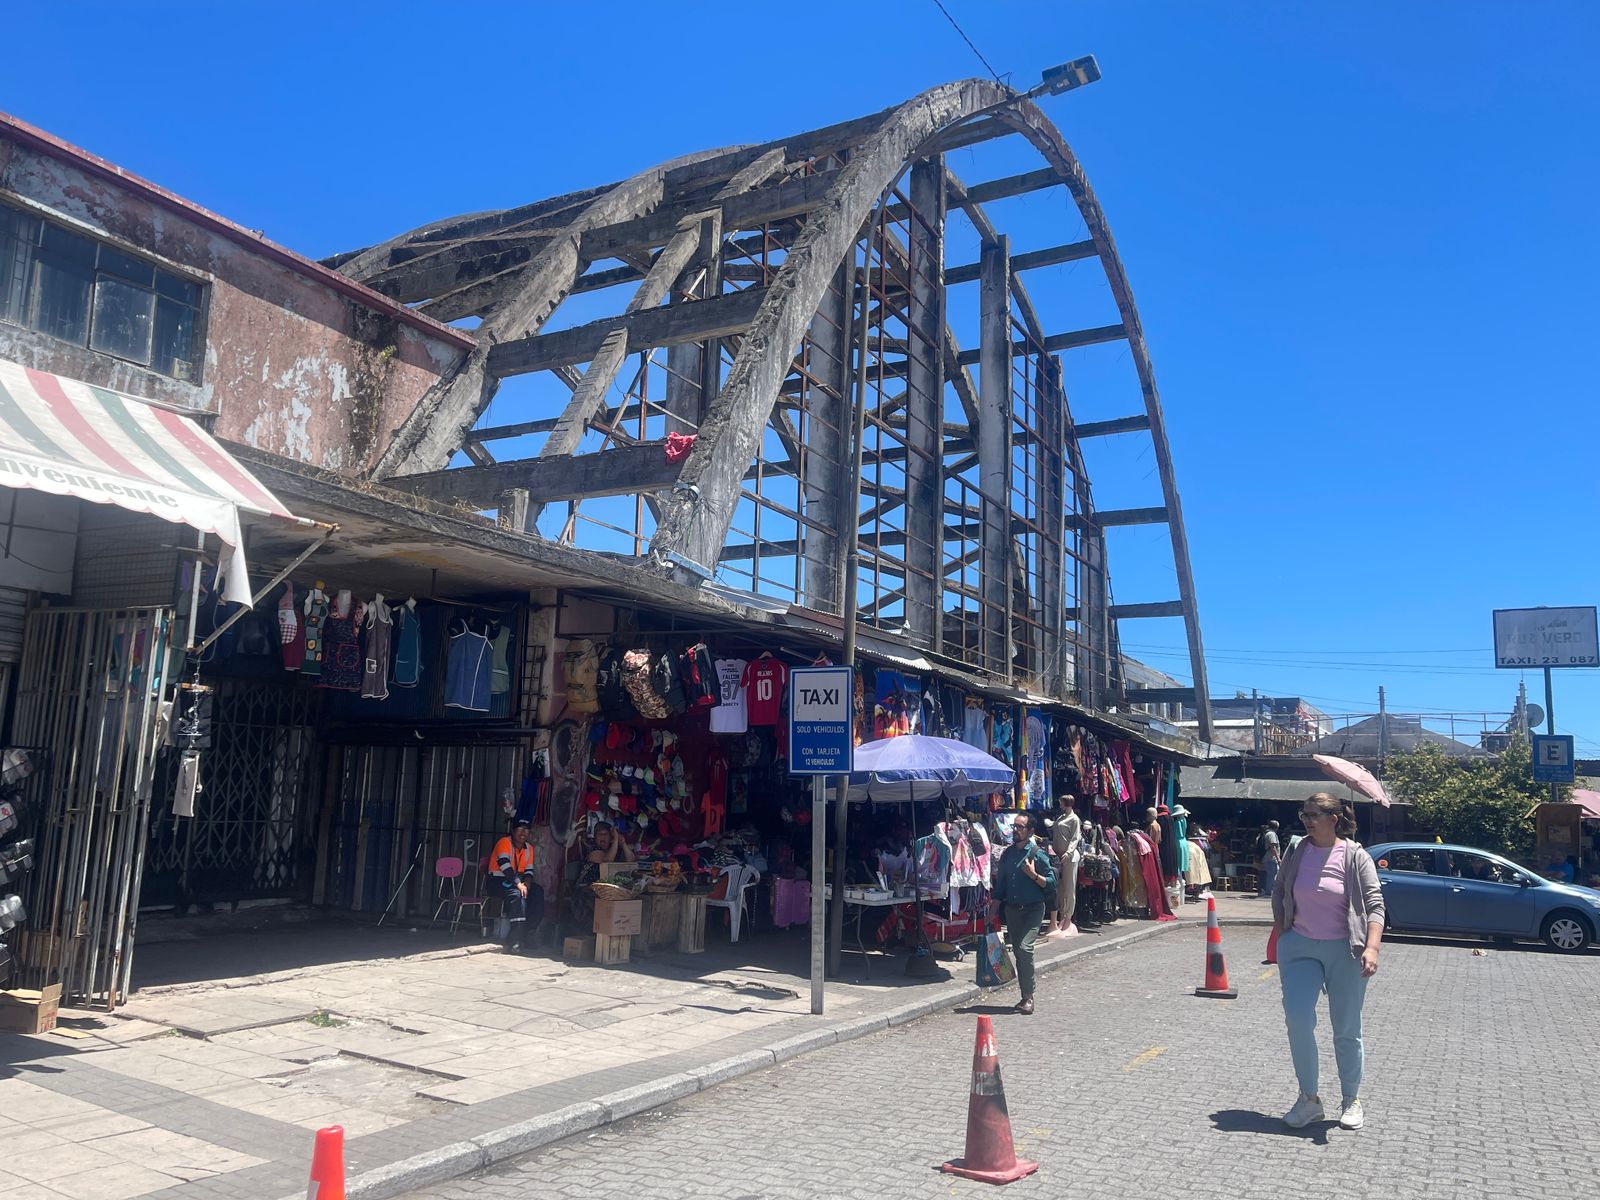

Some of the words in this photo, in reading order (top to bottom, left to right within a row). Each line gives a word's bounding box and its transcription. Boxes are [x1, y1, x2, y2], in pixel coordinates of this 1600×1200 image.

[1499, 656, 1537, 665] TAXI:
[1542, 656, 1559, 664] 23
[1569, 655, 1595, 664] 087
[721, 680, 741, 700] 37
[756, 679, 773, 701] 10
[799, 688, 839, 705] TAXI
[796, 725, 811, 734] SOLO
[813, 725, 845, 734] VEHICULOS
[801, 747, 814, 755] CON
[816, 747, 841, 756] TARJETA
[1547, 745, 1560, 761] E
